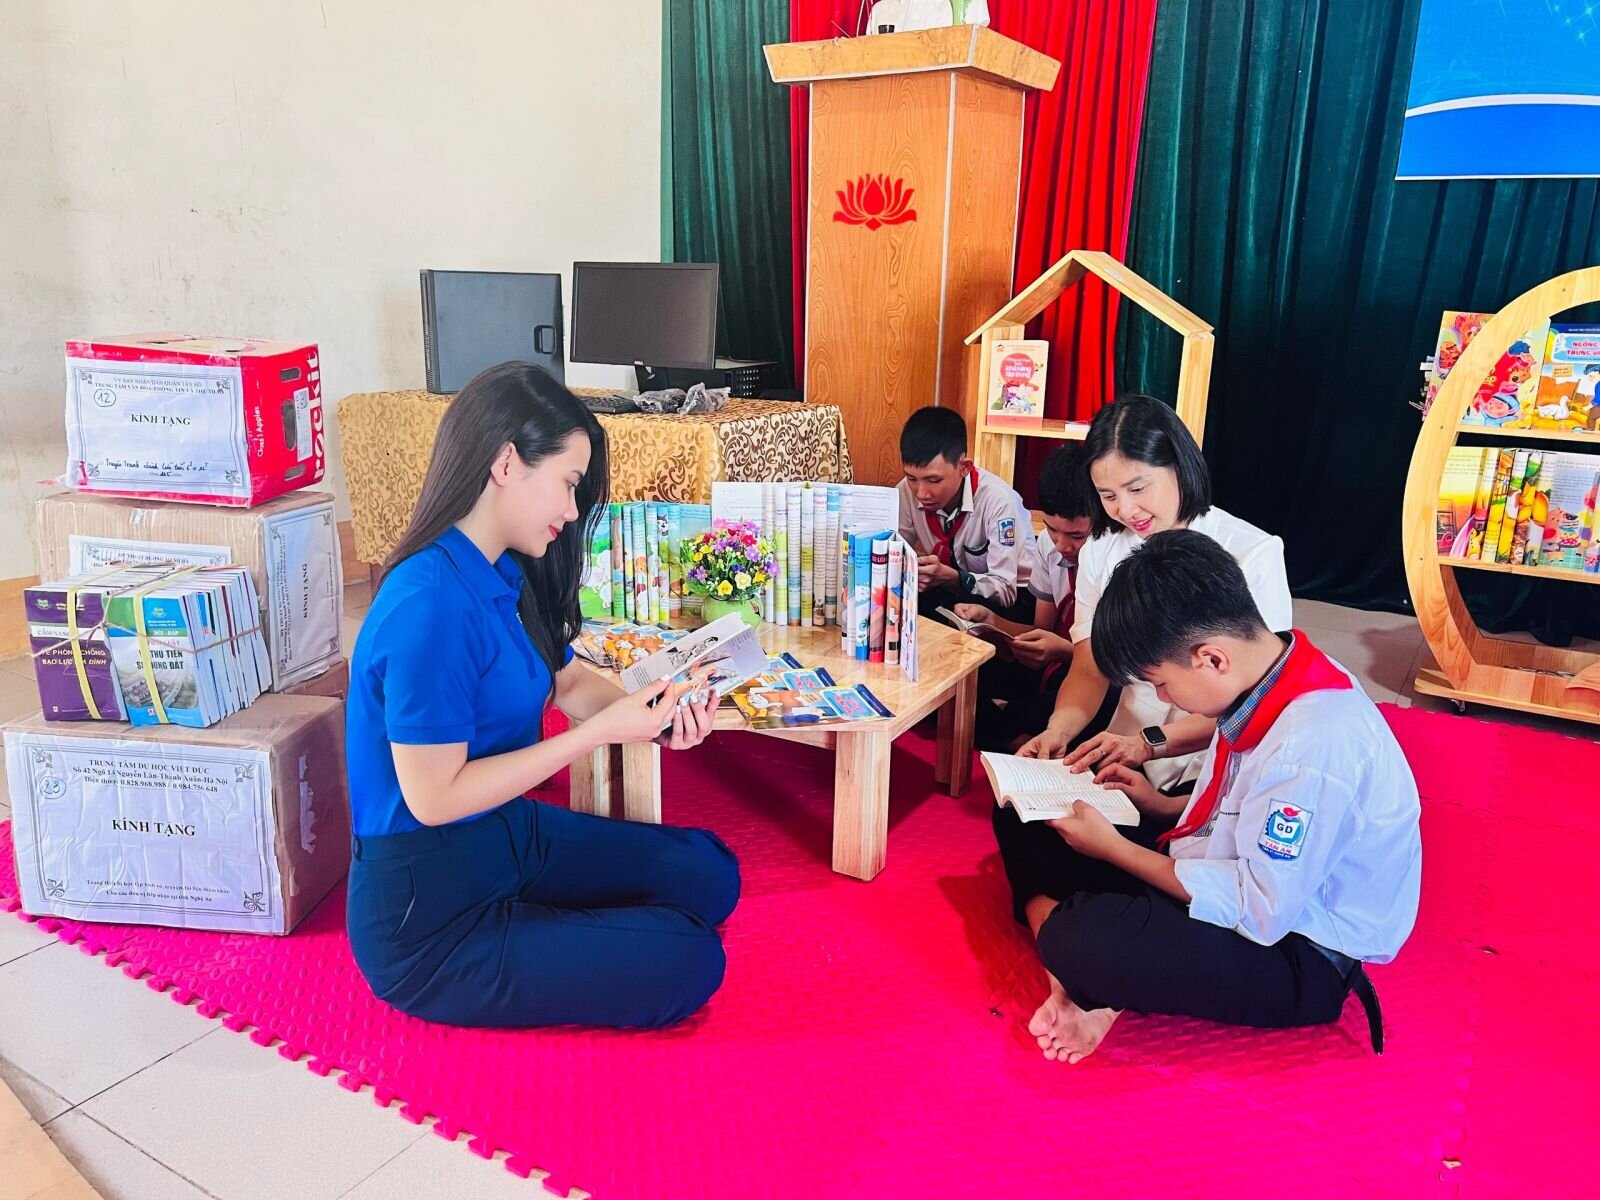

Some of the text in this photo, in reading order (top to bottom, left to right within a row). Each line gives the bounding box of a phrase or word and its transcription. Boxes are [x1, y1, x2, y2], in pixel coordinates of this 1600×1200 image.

[98, 392, 110, 404] 12
[130, 412, 158, 424] KÍNH
[52, 648, 72, 656] PHÒN
[112, 817, 150, 832] KÍNH
[1276, 822, 1294, 834] GD
